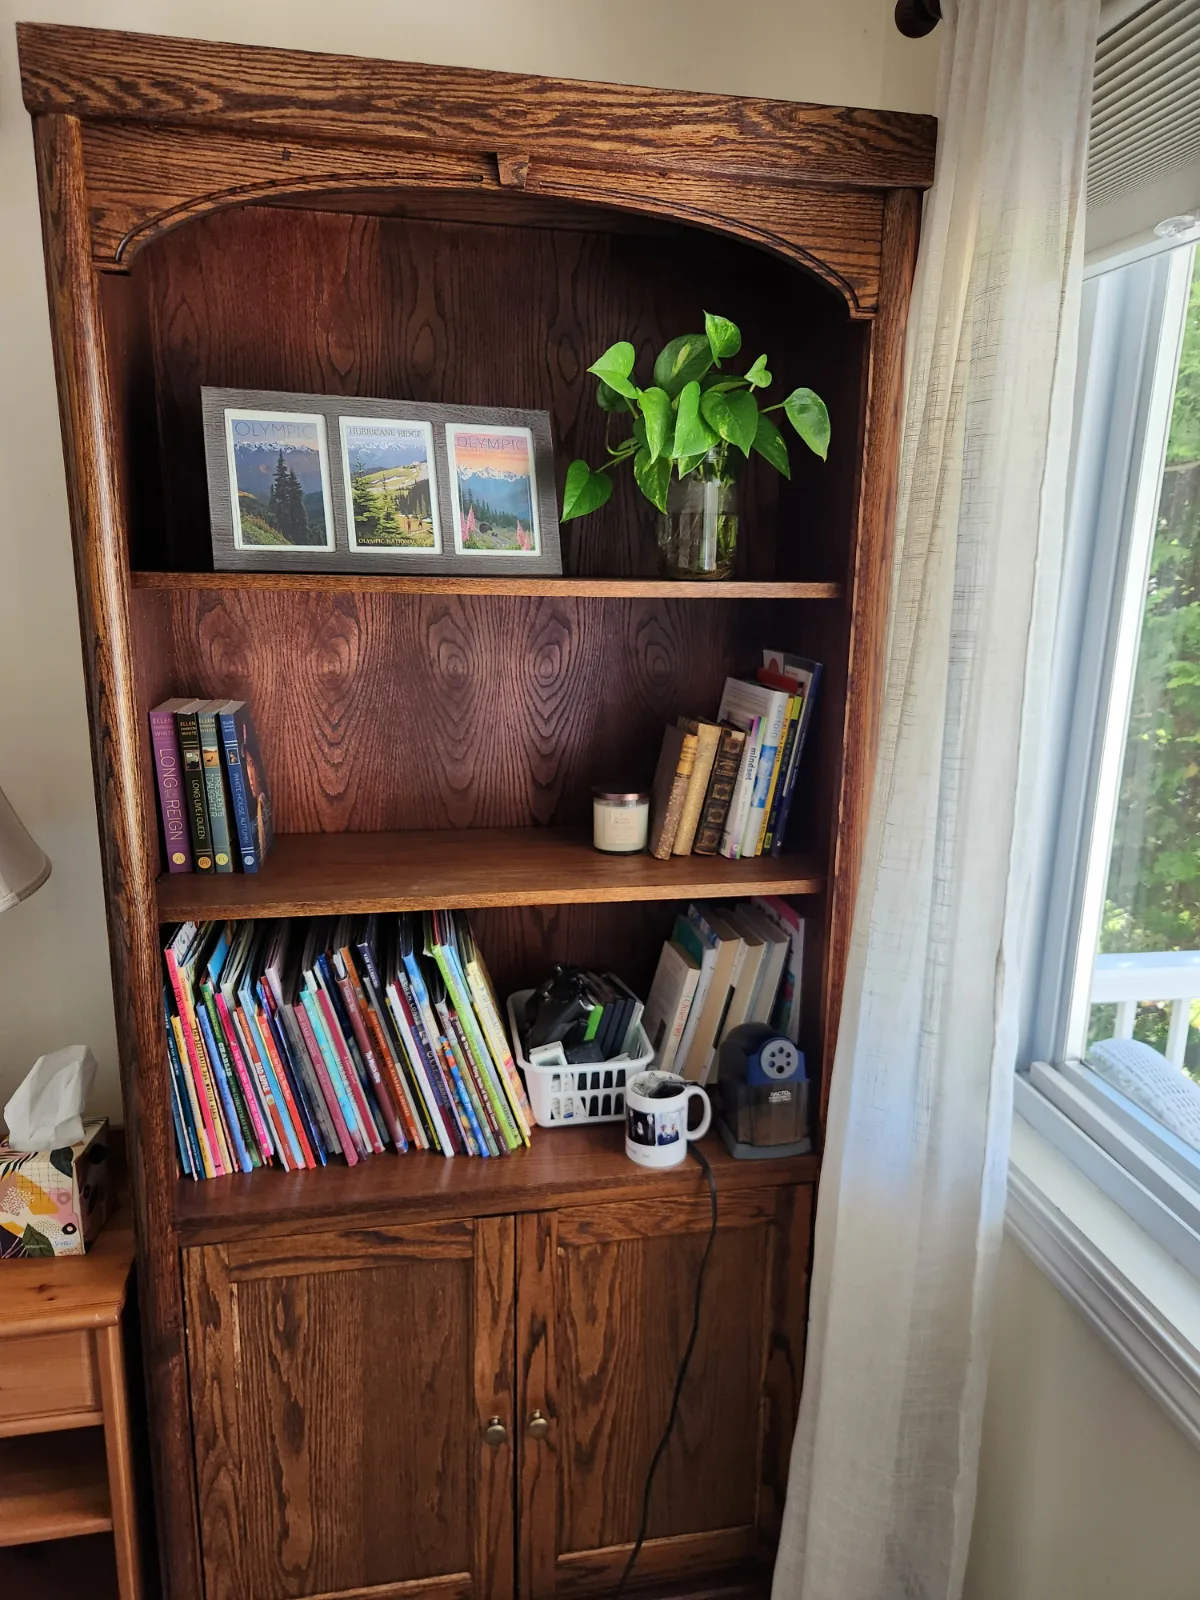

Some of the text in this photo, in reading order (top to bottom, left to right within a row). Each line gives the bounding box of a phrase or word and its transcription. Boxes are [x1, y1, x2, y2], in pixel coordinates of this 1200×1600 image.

[235, 422, 314, 439] OLYMPIC
[349, 428, 422, 438] HURRICANE RIDGE
[457, 437, 525, 451] OLYMPIC
[160, 749, 178, 788] LONG
[745, 748, 757, 780] mindset
[233, 773, 242, 792] WHITE
[166, 800, 183, 840] REIGN
[192, 780, 200, 798] LONG
[196, 816, 205, 840] QUEEN
[362, 952, 370, 963] VAN
[401, 977, 421, 1024] LOREN LONG
[218, 1041, 232, 1076] CHARLIE
[232, 1092, 246, 1125] CHRISTMAS
[254, 1061, 269, 1091] BAD APPLE
